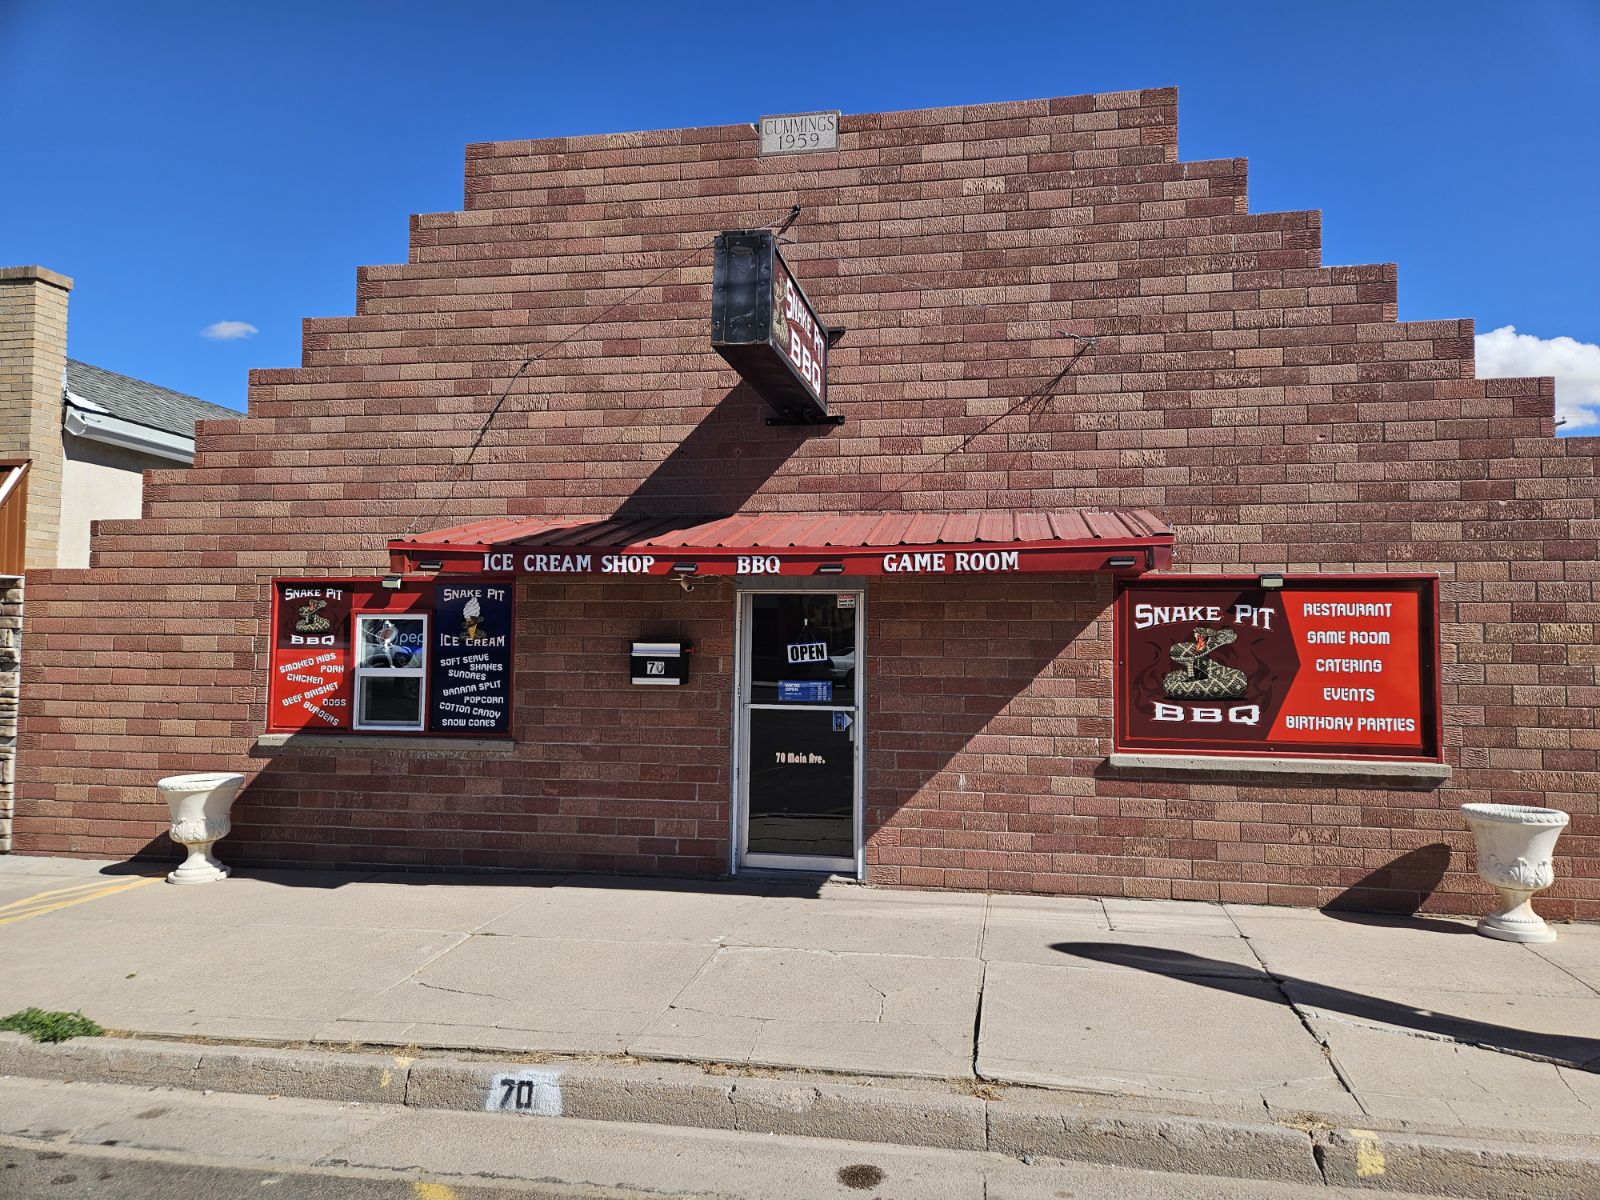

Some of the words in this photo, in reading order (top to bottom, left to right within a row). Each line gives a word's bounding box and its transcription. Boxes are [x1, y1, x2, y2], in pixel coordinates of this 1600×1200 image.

[764, 115, 834, 136] CUMMINGS
[778, 132, 820, 150] 1959
[786, 277, 812, 340] SNAKE
[790, 327, 821, 399] BBQ
[483, 553, 514, 572] ICE
[523, 554, 592, 573] CREAM
[601, 555, 655, 574] SHOP
[736, 556, 781, 574] BBQ
[882, 553, 946, 573] GAME
[955, 551, 1020, 572] ROOM
[285, 588, 322, 601] SNAKE
[325, 588, 343, 601] PIT
[443, 588, 482, 602] SNAKE
[487, 588, 505, 602] PIT
[1134, 603, 1222, 630] SNAKE
[1234, 603, 1276, 631] PIT
[1303, 602, 1392, 618] RESTAURANT
[290, 634, 336, 646] BBQ
[440, 633, 460, 647] ICE
[465, 635, 505, 647] CREAM
[1306, 631, 1346, 645] GAME
[1349, 631, 1391, 645] ROOM
[440, 657, 461, 667] SOFT
[462, 653, 490, 664] SERVE
[790, 644, 825, 662] OPEN
[279, 658, 315, 673] SMOKED
[316, 652, 337, 664] RIBS
[320, 665, 345, 673] PORK
[469, 663, 503, 671] SHAKES
[1315, 658, 1382, 673] CATERING
[286, 673, 323, 685] CHICKEN
[448, 669, 487, 681] SUNDAES
[282, 693, 303, 706] BEEF
[303, 682, 339, 699] BRISKET
[442, 684, 477, 697] BANANA
[478, 680, 501, 691] SPLIT
[1323, 687, 1375, 702] EVENTS
[322, 698, 347, 706] DOGS
[464, 696, 504, 704] POPCORN
[303, 701, 340, 726] BURGERS
[439, 702, 471, 714] COTTON
[472, 707, 501, 719] CANDY
[1152, 701, 1261, 726] BBQ
[442, 718, 466, 726] SNOW
[468, 718, 496, 727] CONES
[1285, 715, 1354, 732] BIRTHDAY
[1357, 716, 1415, 732] PARTIES
[775, 752, 786, 763] 70
[787, 752, 807, 764] Main
[808, 752, 826, 764] Ave.
[499, 1078, 534, 1109] 70
